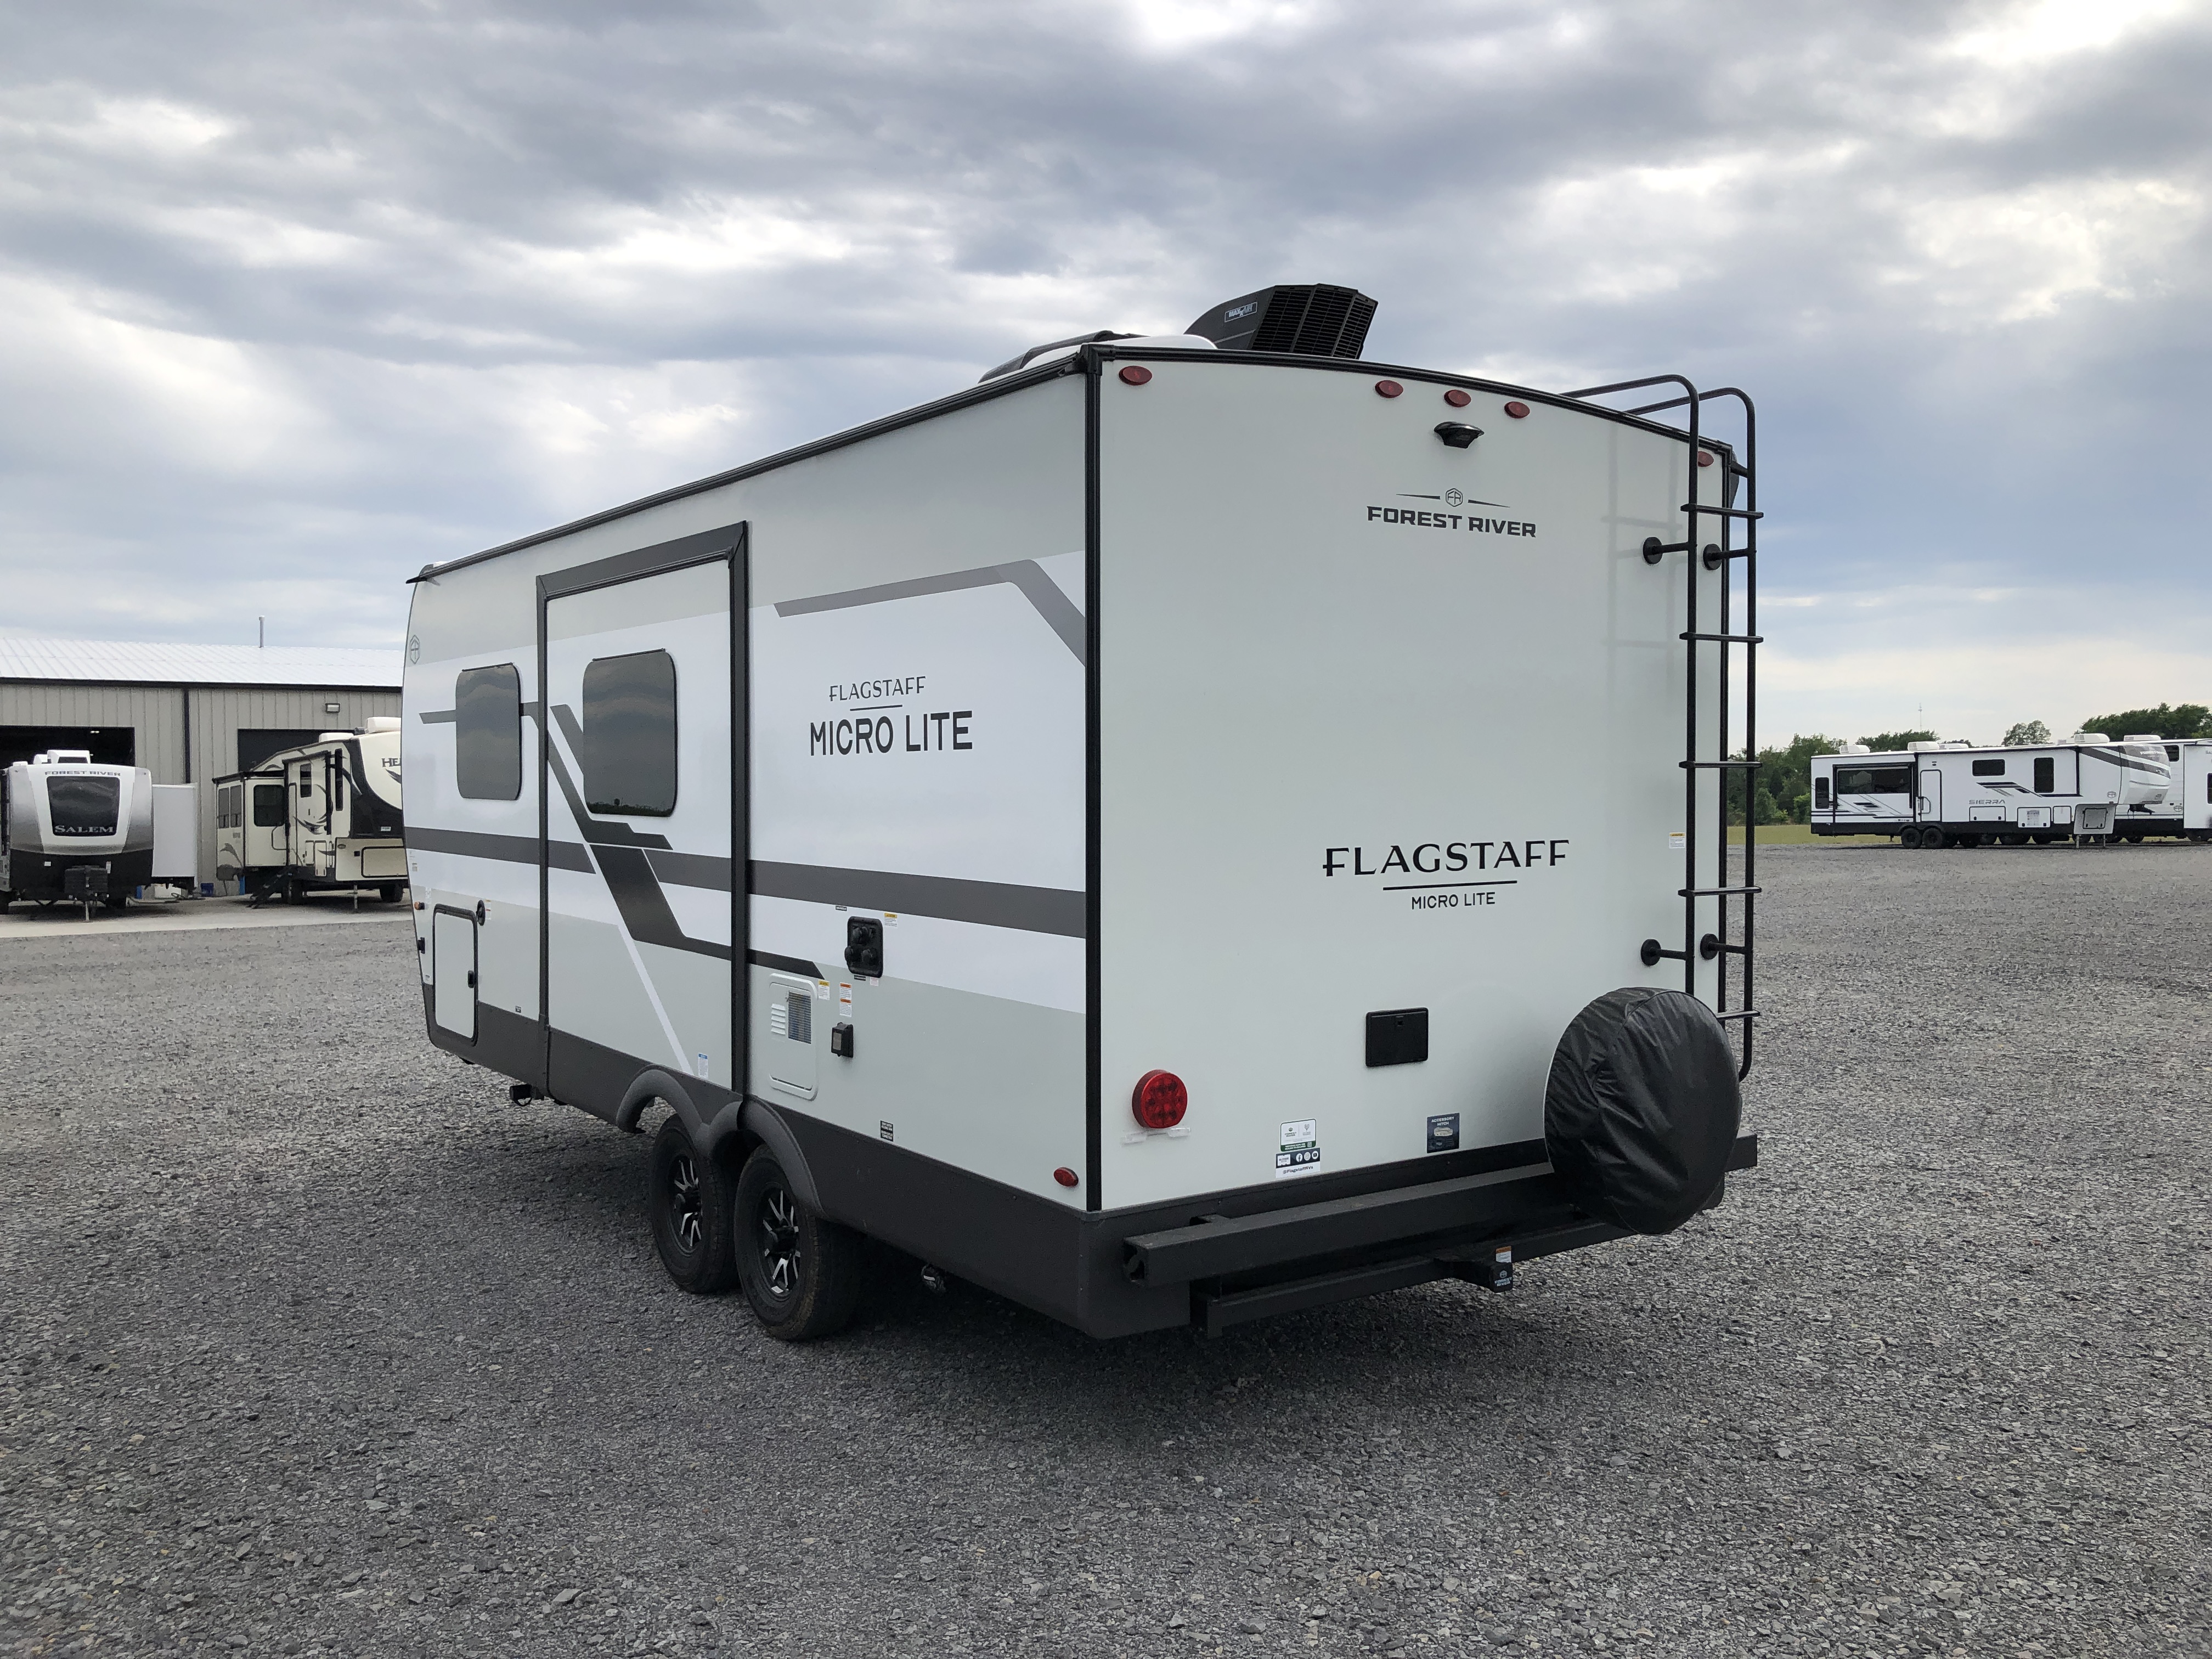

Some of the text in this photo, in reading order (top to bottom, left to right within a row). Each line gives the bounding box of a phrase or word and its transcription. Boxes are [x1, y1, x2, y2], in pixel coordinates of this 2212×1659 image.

[1366, 505, 1536, 538] FOREST RIVER
[829, 675, 926, 702] FLAGSTAFF
[810, 710, 973, 757] MICRO LITE
[1322, 839, 1570, 877] FLAGSTAFF
[1411, 891, 1496, 910] MICRO LITE
